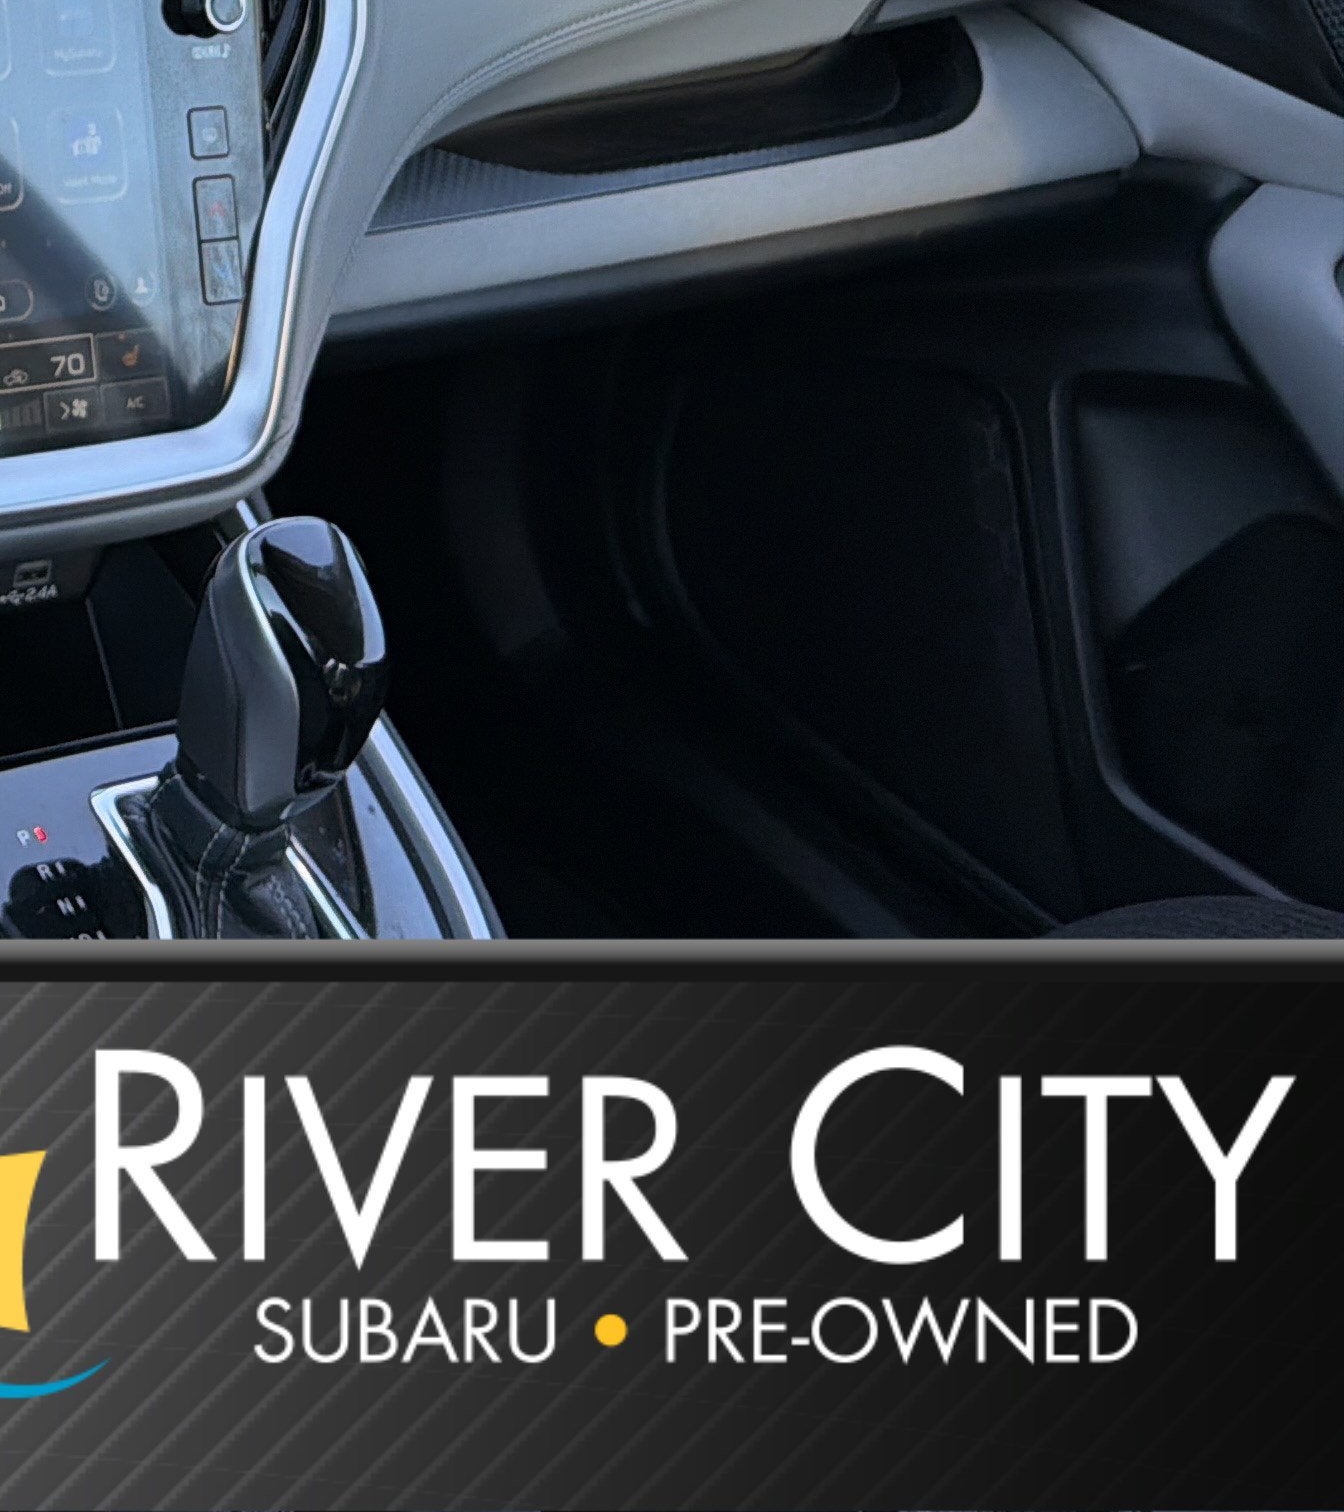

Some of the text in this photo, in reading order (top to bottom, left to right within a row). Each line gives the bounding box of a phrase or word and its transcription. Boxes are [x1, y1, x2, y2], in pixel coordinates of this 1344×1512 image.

[50, 353, 86, 378] 70
[16, 829, 30, 847] P
[36, 863, 54, 882] R
[56, 896, 75, 916] N
